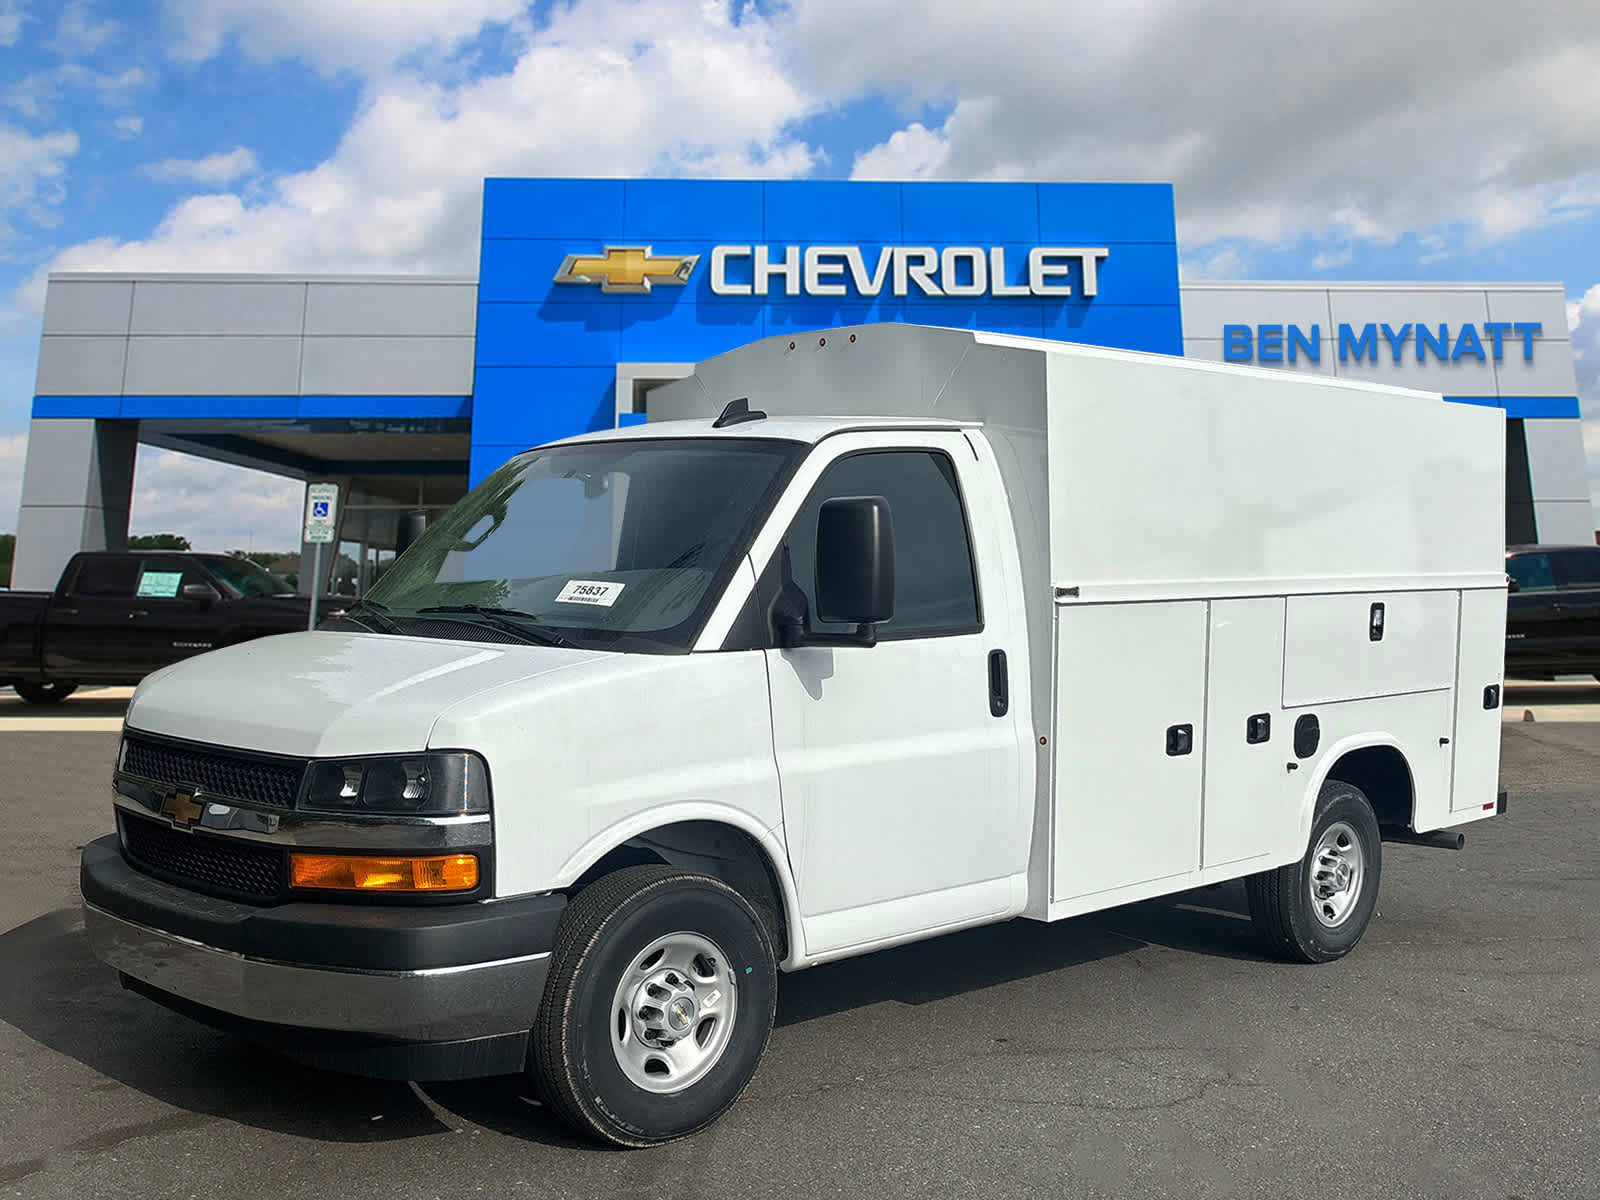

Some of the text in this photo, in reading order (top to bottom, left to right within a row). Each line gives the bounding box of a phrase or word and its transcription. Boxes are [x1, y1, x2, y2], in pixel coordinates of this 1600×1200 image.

[710, 245, 1109, 297] CHEVROLET
[1223, 322, 1542, 361] BEN MYNATT
[572, 584, 609, 597] 75837
